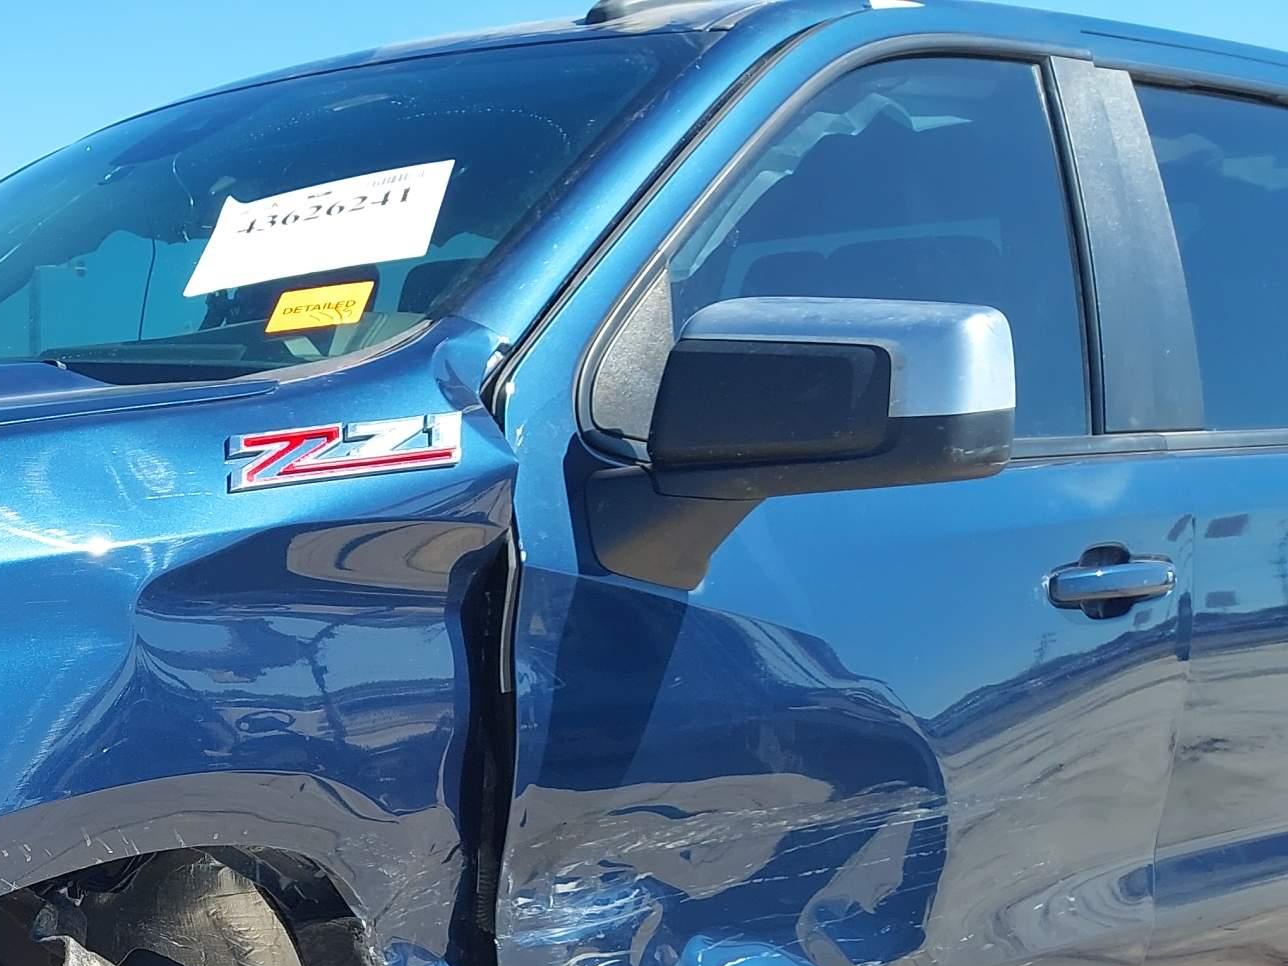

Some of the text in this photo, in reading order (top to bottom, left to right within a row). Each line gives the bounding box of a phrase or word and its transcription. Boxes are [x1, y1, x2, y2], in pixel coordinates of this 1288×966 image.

[237, 187, 411, 234] 43626241
[282, 299, 357, 316] DETAILED
[225, 411, 462, 493] Z71
